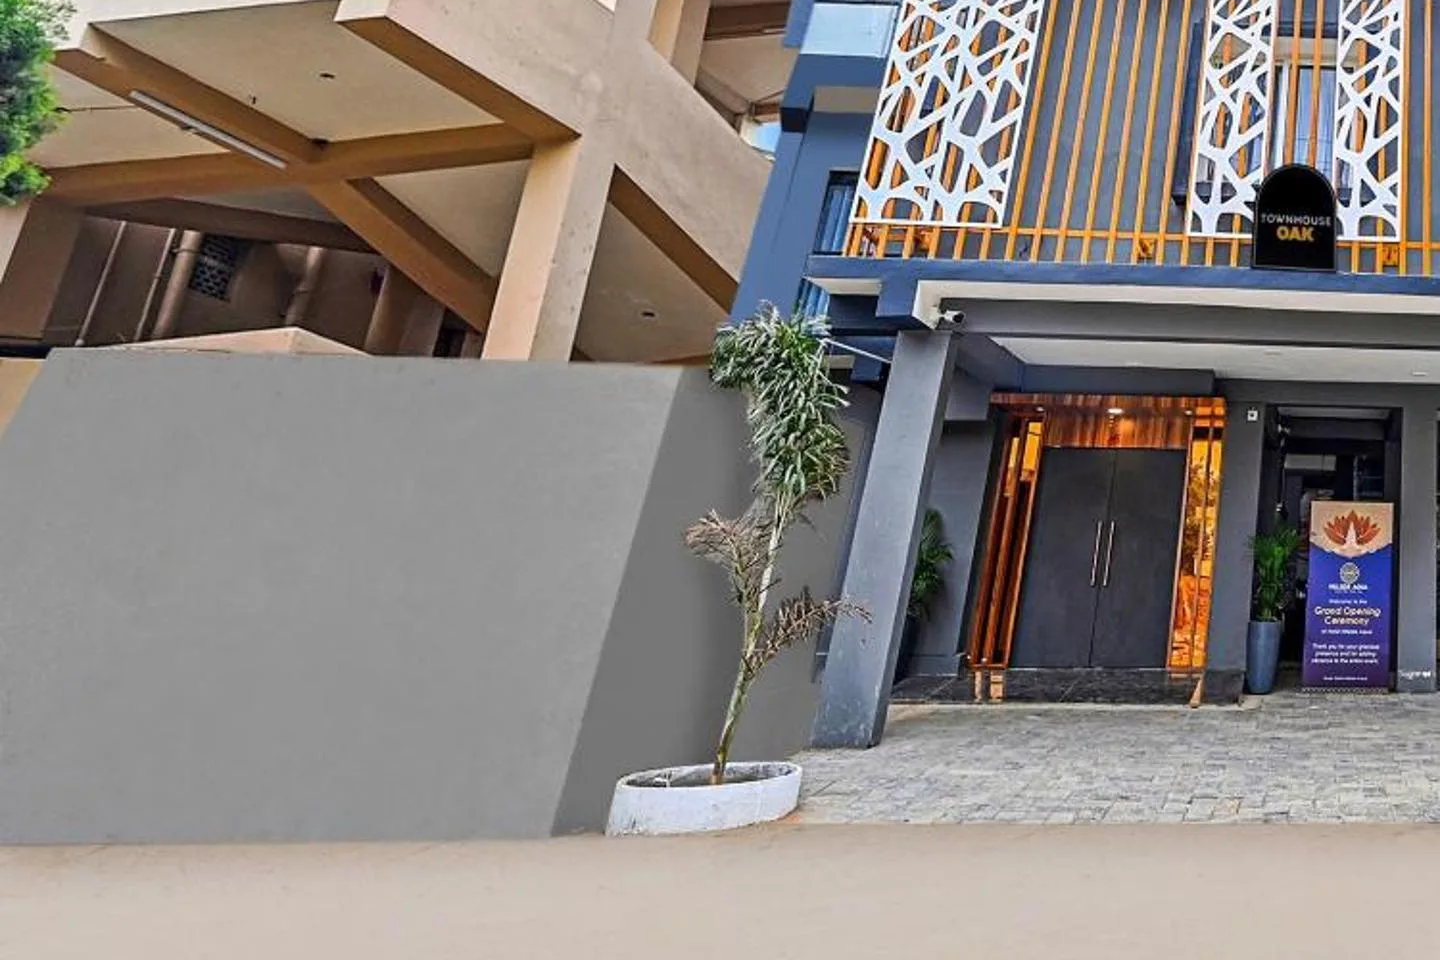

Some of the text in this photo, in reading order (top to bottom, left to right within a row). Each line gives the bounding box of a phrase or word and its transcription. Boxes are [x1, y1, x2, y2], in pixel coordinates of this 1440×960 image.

[1261, 213, 1332, 227] TOWNHOUSE
[1276, 226, 1314, 242] OAK
[1314, 606, 1382, 618] Grand Opening
[1324, 616, 1370, 626] Ceremony
